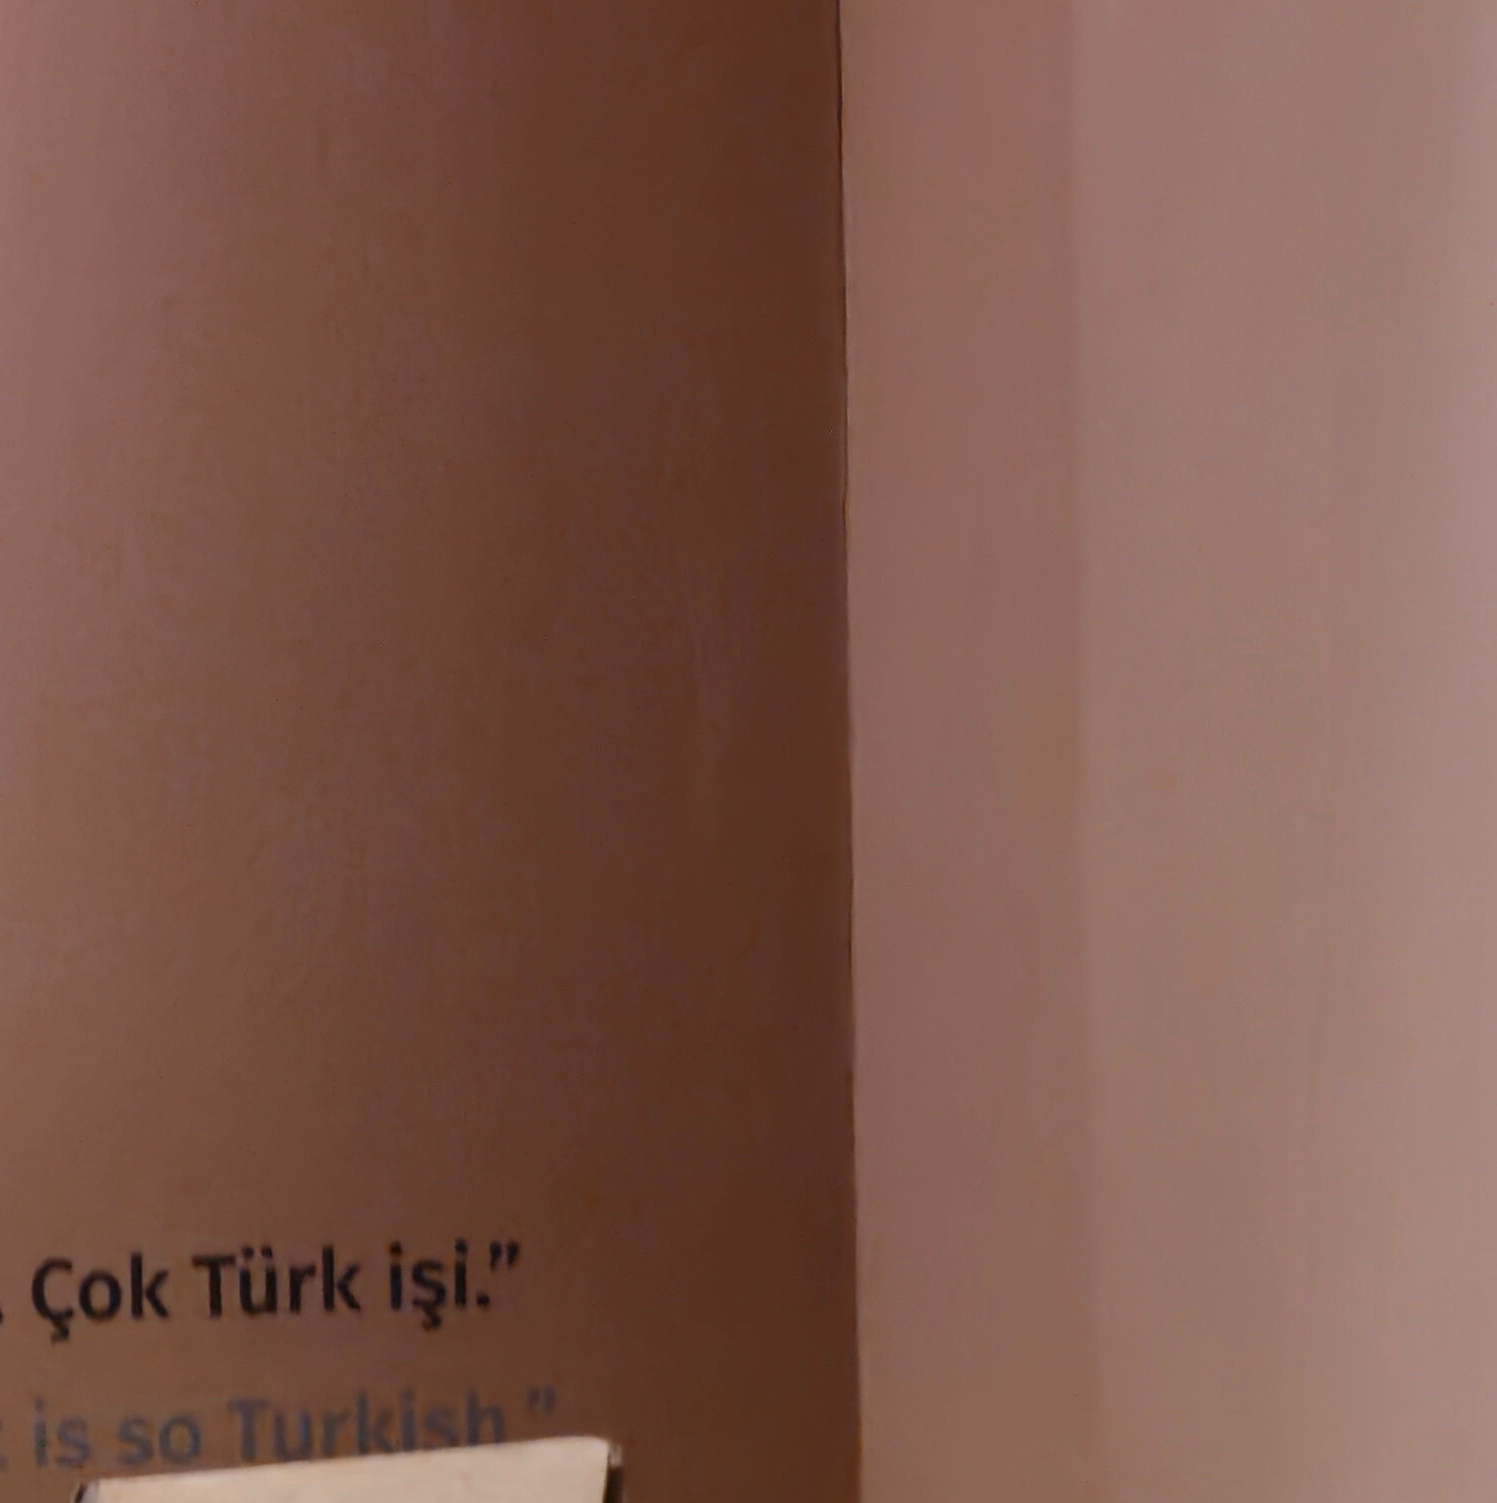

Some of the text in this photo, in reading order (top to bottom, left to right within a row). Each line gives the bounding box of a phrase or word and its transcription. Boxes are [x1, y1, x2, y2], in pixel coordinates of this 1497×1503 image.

[30, 1250, 170, 1343] Çok
[191, 1241, 362, 1319] Türk
[386, 1238, 521, 1332] işi.”
[32, 1393, 93, 1468] is
[117, 1410, 203, 1467] so
